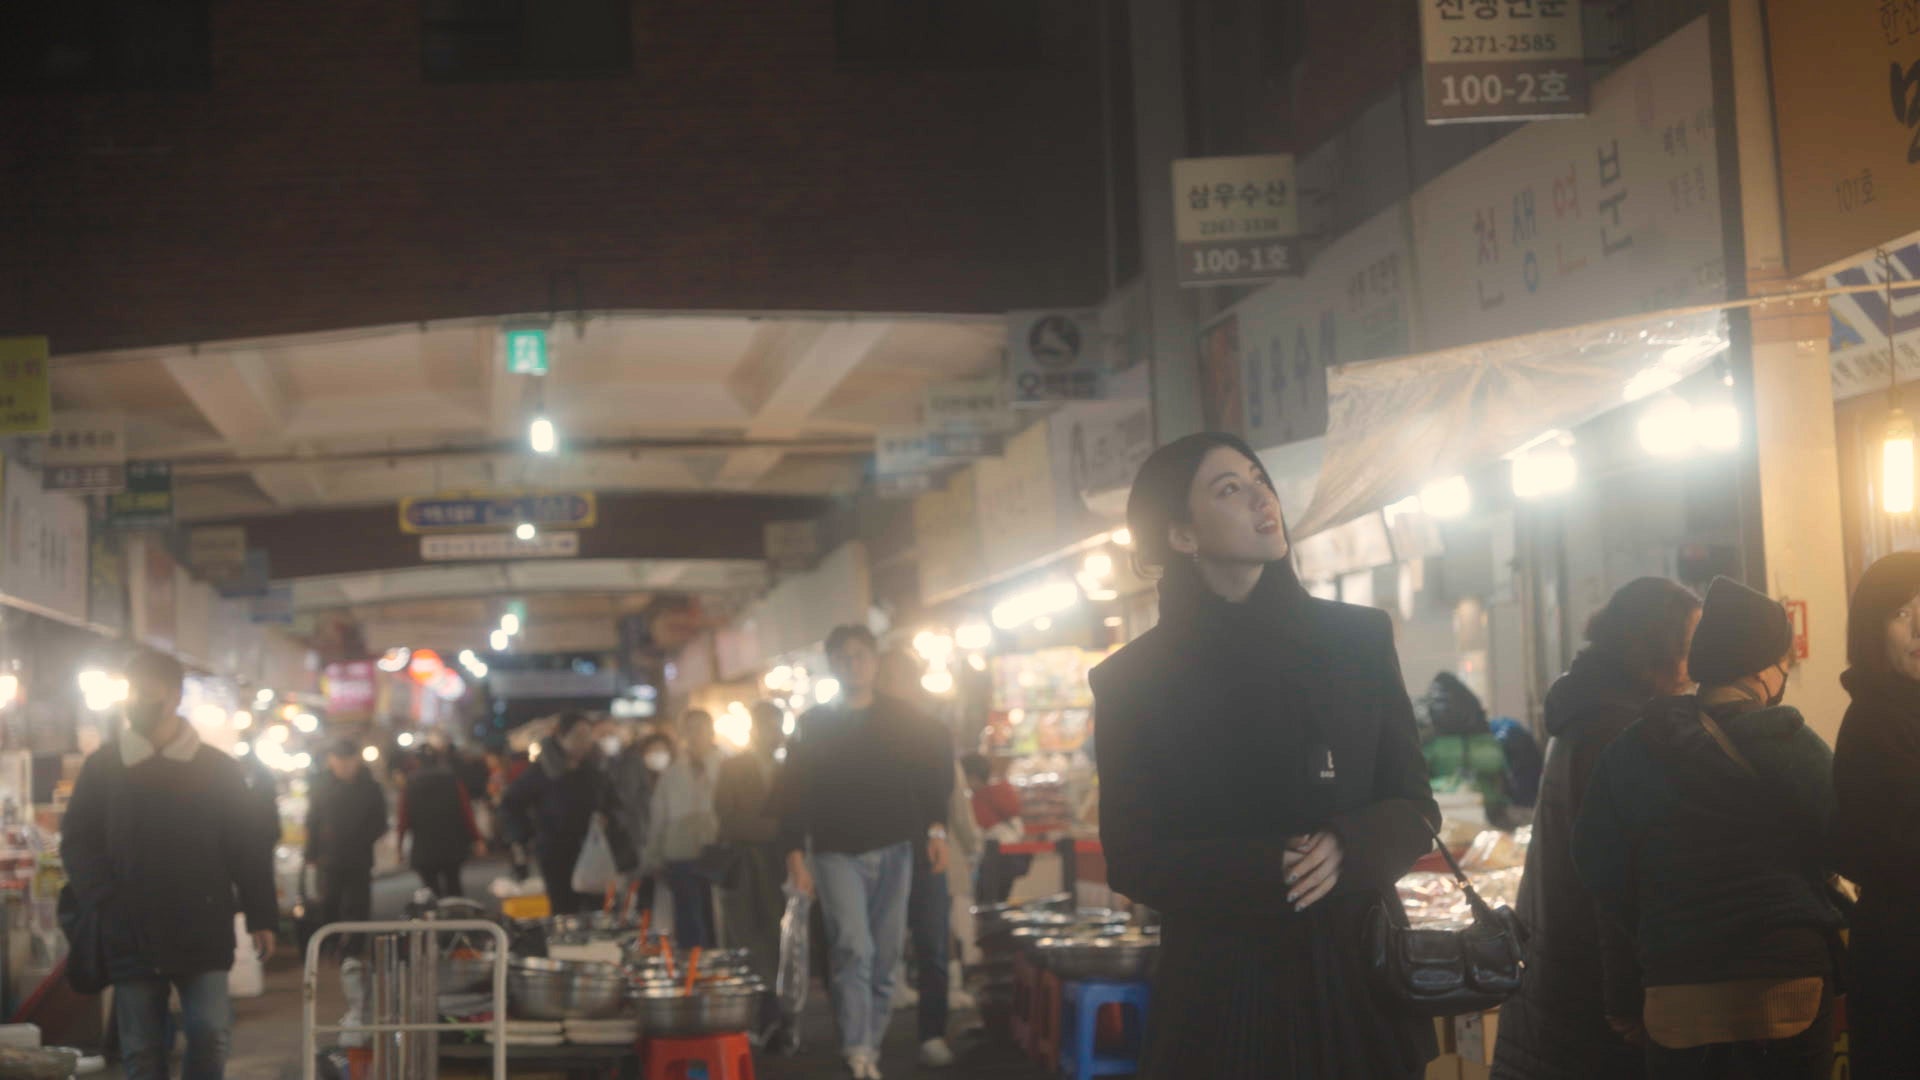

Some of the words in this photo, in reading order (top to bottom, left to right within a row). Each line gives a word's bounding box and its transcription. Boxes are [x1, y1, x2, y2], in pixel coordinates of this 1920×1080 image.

[1451, 34, 1556, 54] 2271-2585
[1440, 69, 1571, 107] 100-2호
[1188, 180, 1286, 210] 삼우수산
[1192, 245, 1289, 274] 100-1호
